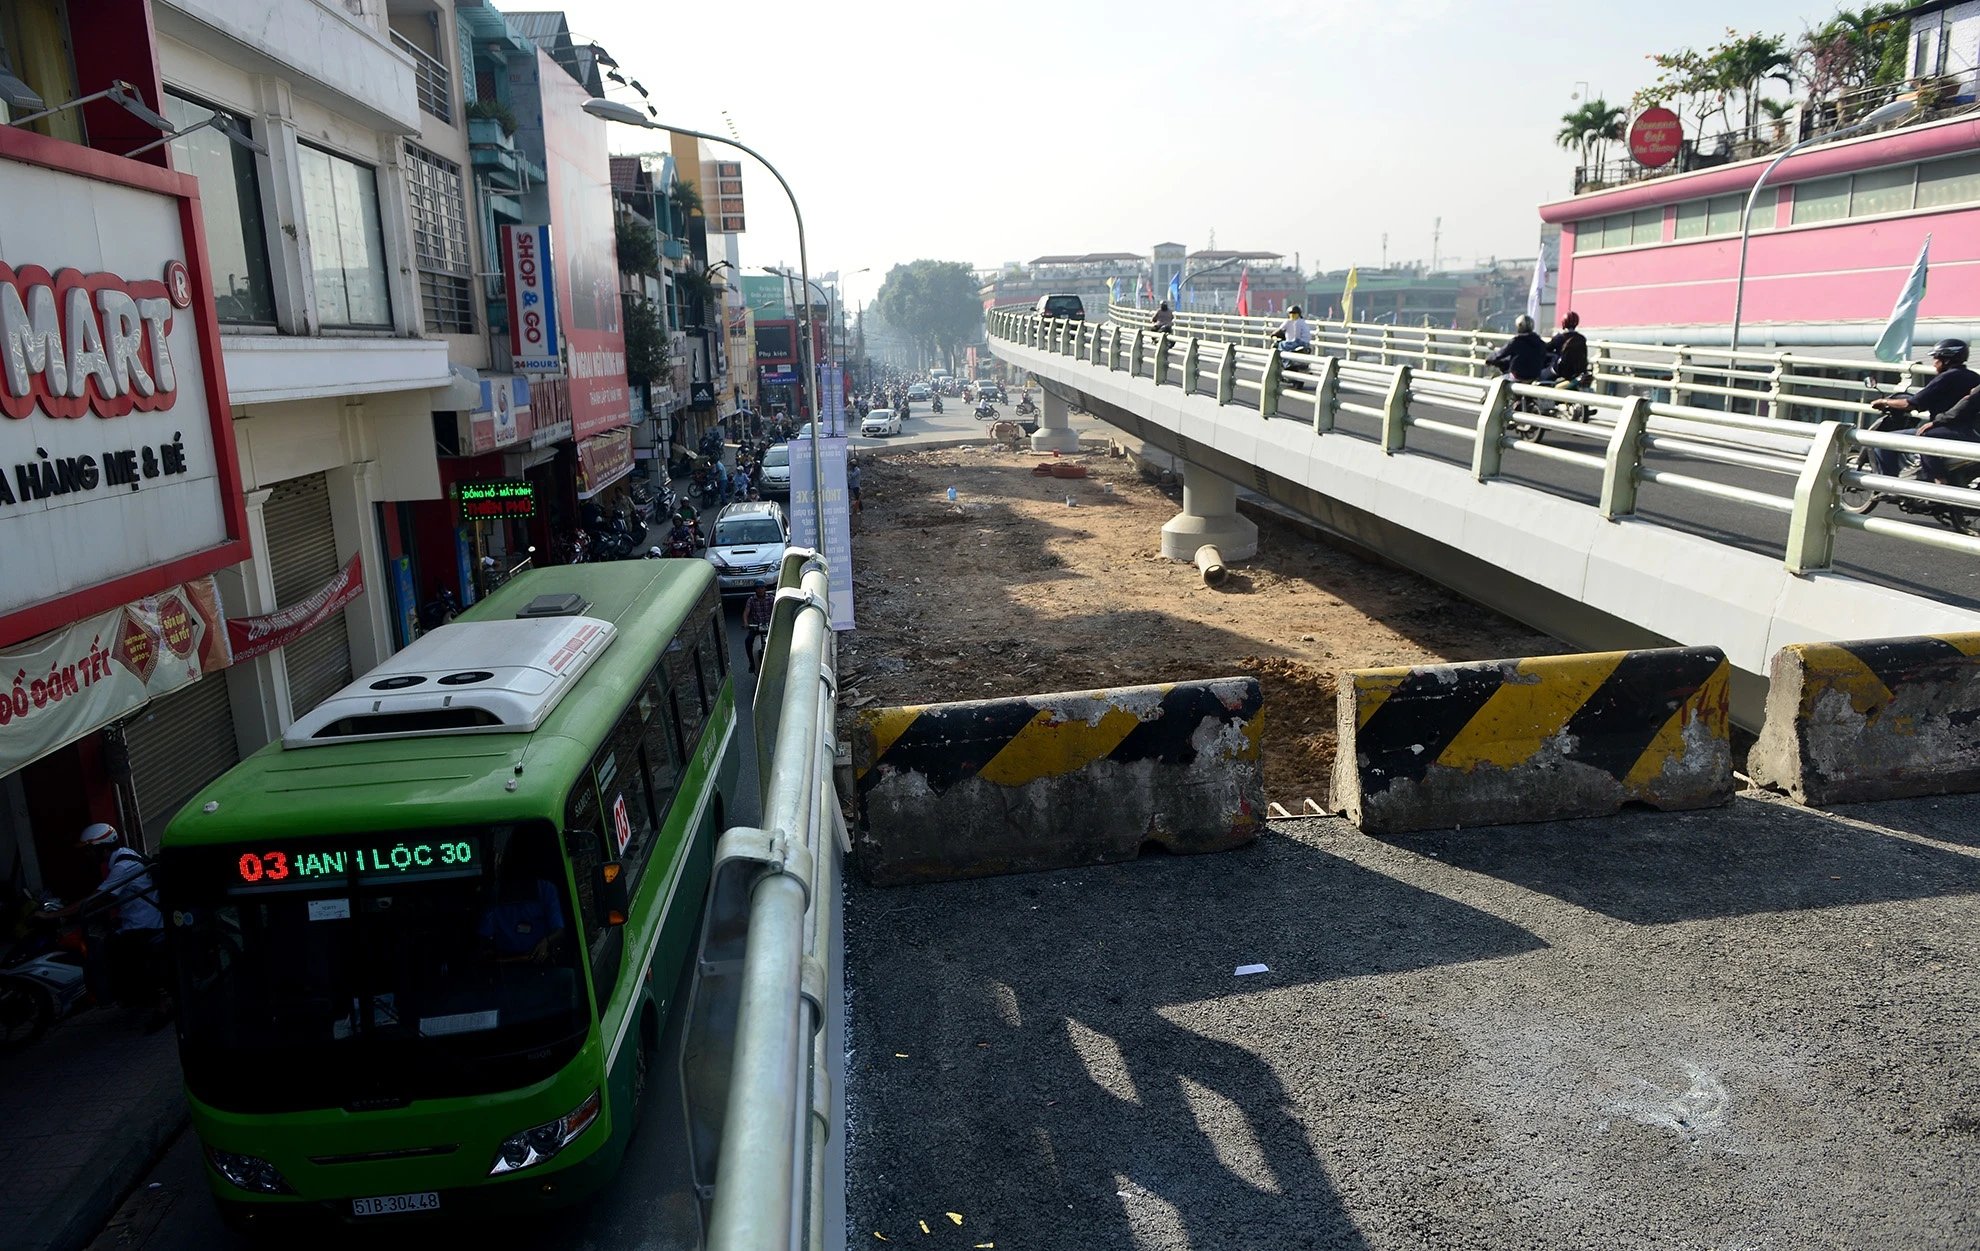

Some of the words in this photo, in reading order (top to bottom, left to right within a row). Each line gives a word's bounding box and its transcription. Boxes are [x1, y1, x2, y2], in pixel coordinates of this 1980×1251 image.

[517, 232, 536, 288] SHOP
[522, 290, 539, 309] &
[0, 281, 176, 400] MART
[523, 310, 541, 345] GO
[15, 446, 100, 503] HÀNG
[102, 449, 141, 492] MẸ
[142, 445, 160, 479] &
[160, 430, 188, 476] BÉ
[30, 660, 79, 710] ĐÓN
[77, 633, 113, 688] TẾT
[615, 799, 629, 847] 03
[238, 850, 289, 882] 03
[371, 843, 434, 872] LỘC
[439, 841, 472, 864] 30
[354, 1193, 438, 1214] 51B-304.48
